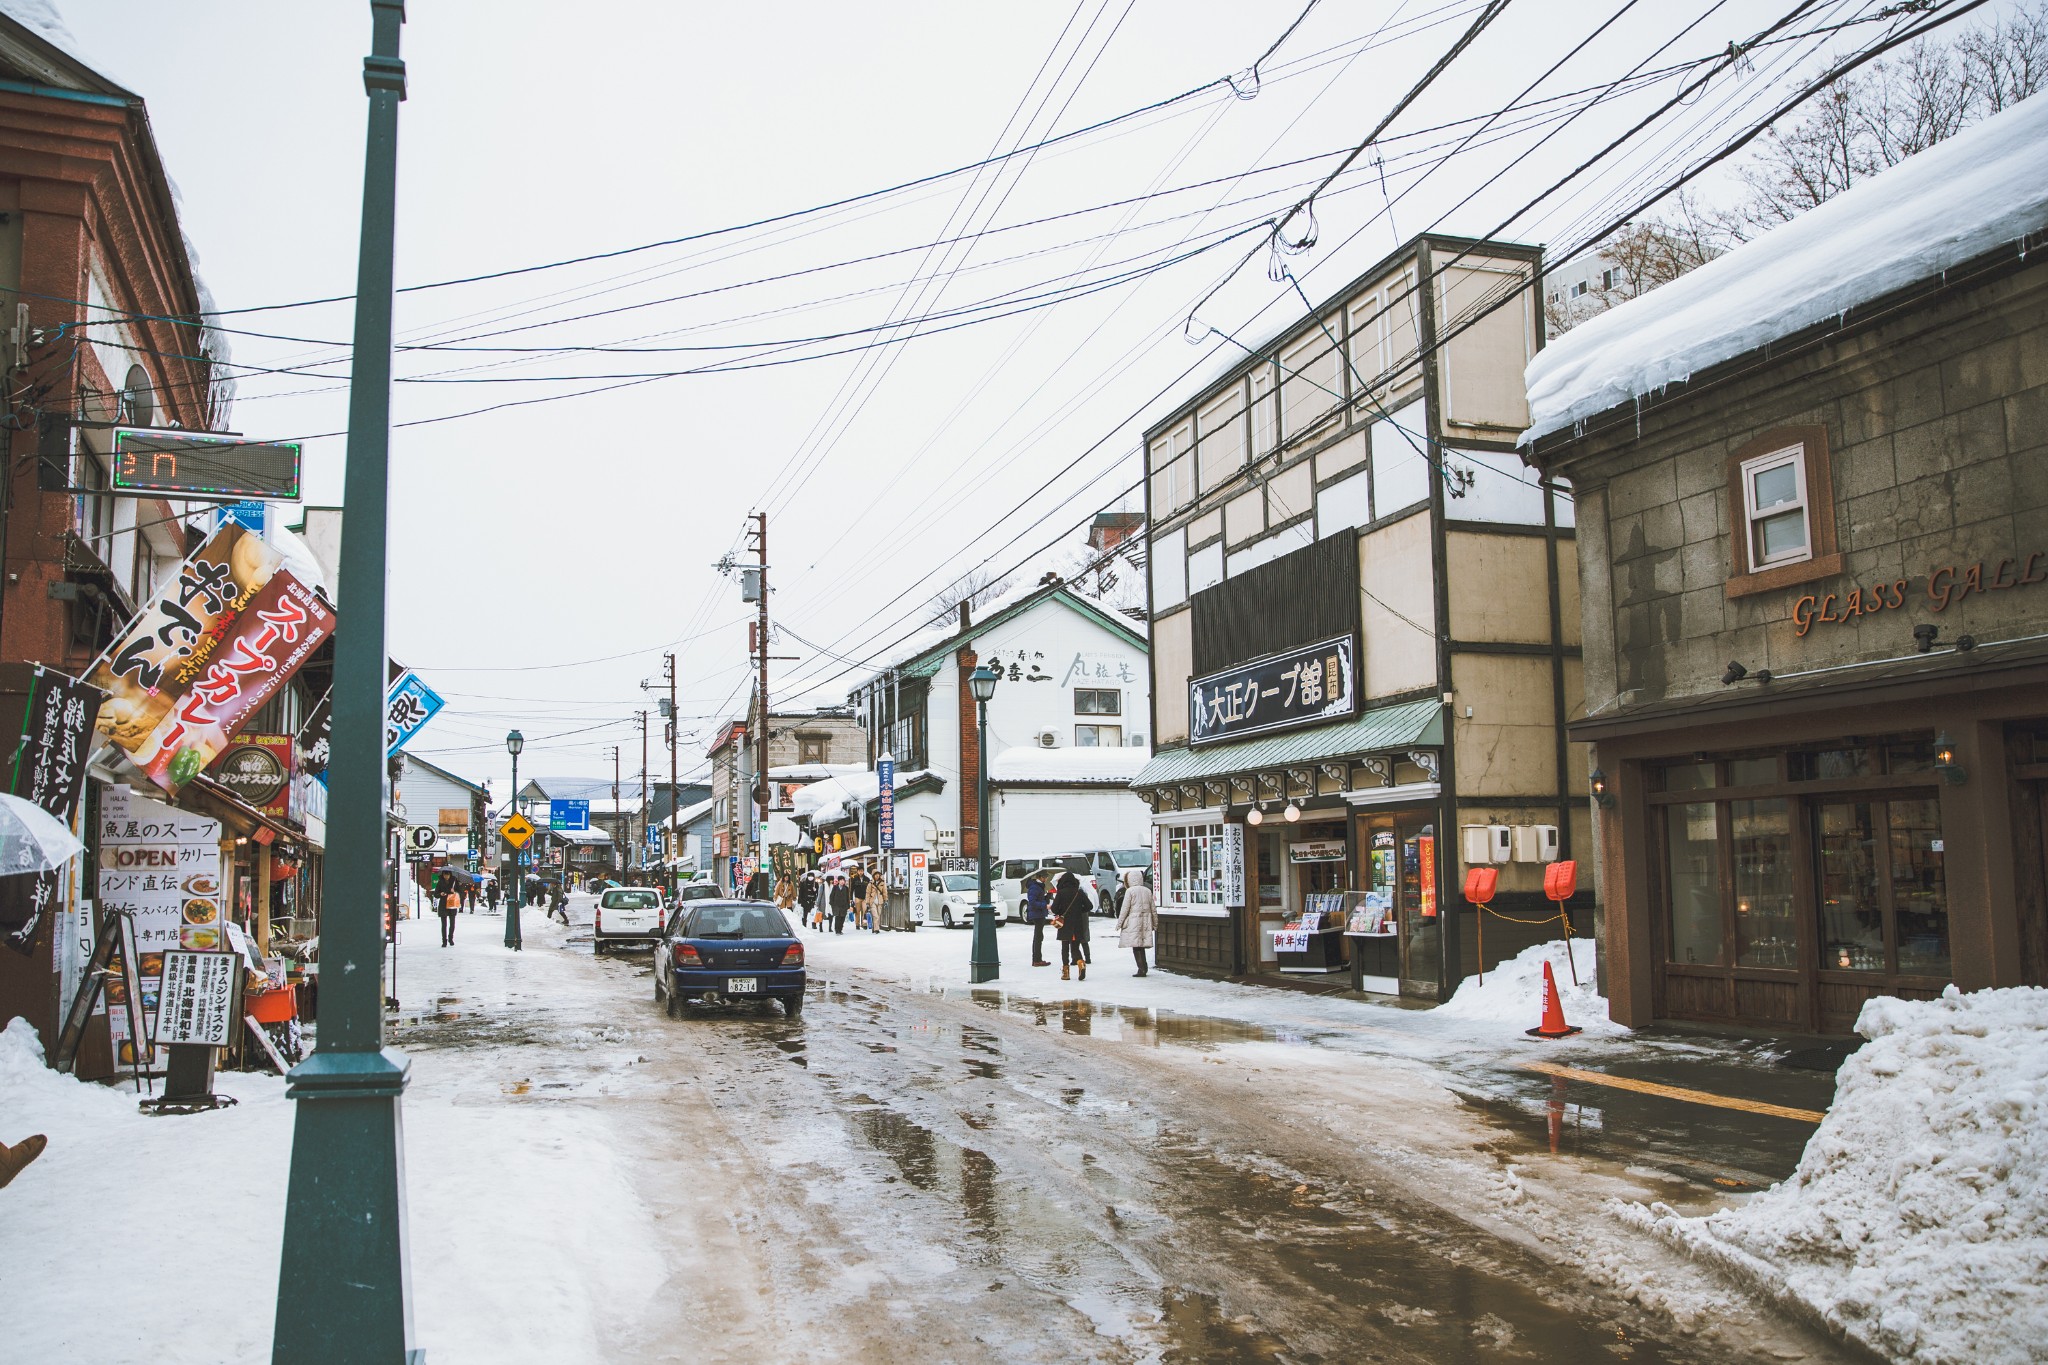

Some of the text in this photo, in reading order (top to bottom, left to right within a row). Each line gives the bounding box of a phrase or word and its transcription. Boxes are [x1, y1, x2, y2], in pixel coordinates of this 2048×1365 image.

[228, 509, 264, 517] XPRESS
[1793, 551, 2048, 637] GLASS GALL
[111, 560, 237, 690] おでん
[162, 594, 307, 751] スープカレー
[988, 656, 1053, 682] 多喜二
[1328, 661, 1337, 695] 昆布
[219, 773, 282, 785] ジンギスカン
[102, 821, 217, 838] 魚屋のスープ
[419, 829, 432, 846] P
[119, 849, 176, 866] OPEN
[180, 848, 217, 862] カリー
[914, 856, 923, 865] P
[1232, 827, 1242, 902] お父さん預ります
[914, 870, 924, 918] 利尻屋みのや
[134, 929, 178, 942] 専門店
[1274, 935, 1307, 947] 新年好
[734, 983, 755, 991] 82-14
[211, 957, 230, 1042] 生ラムジンギスカン
